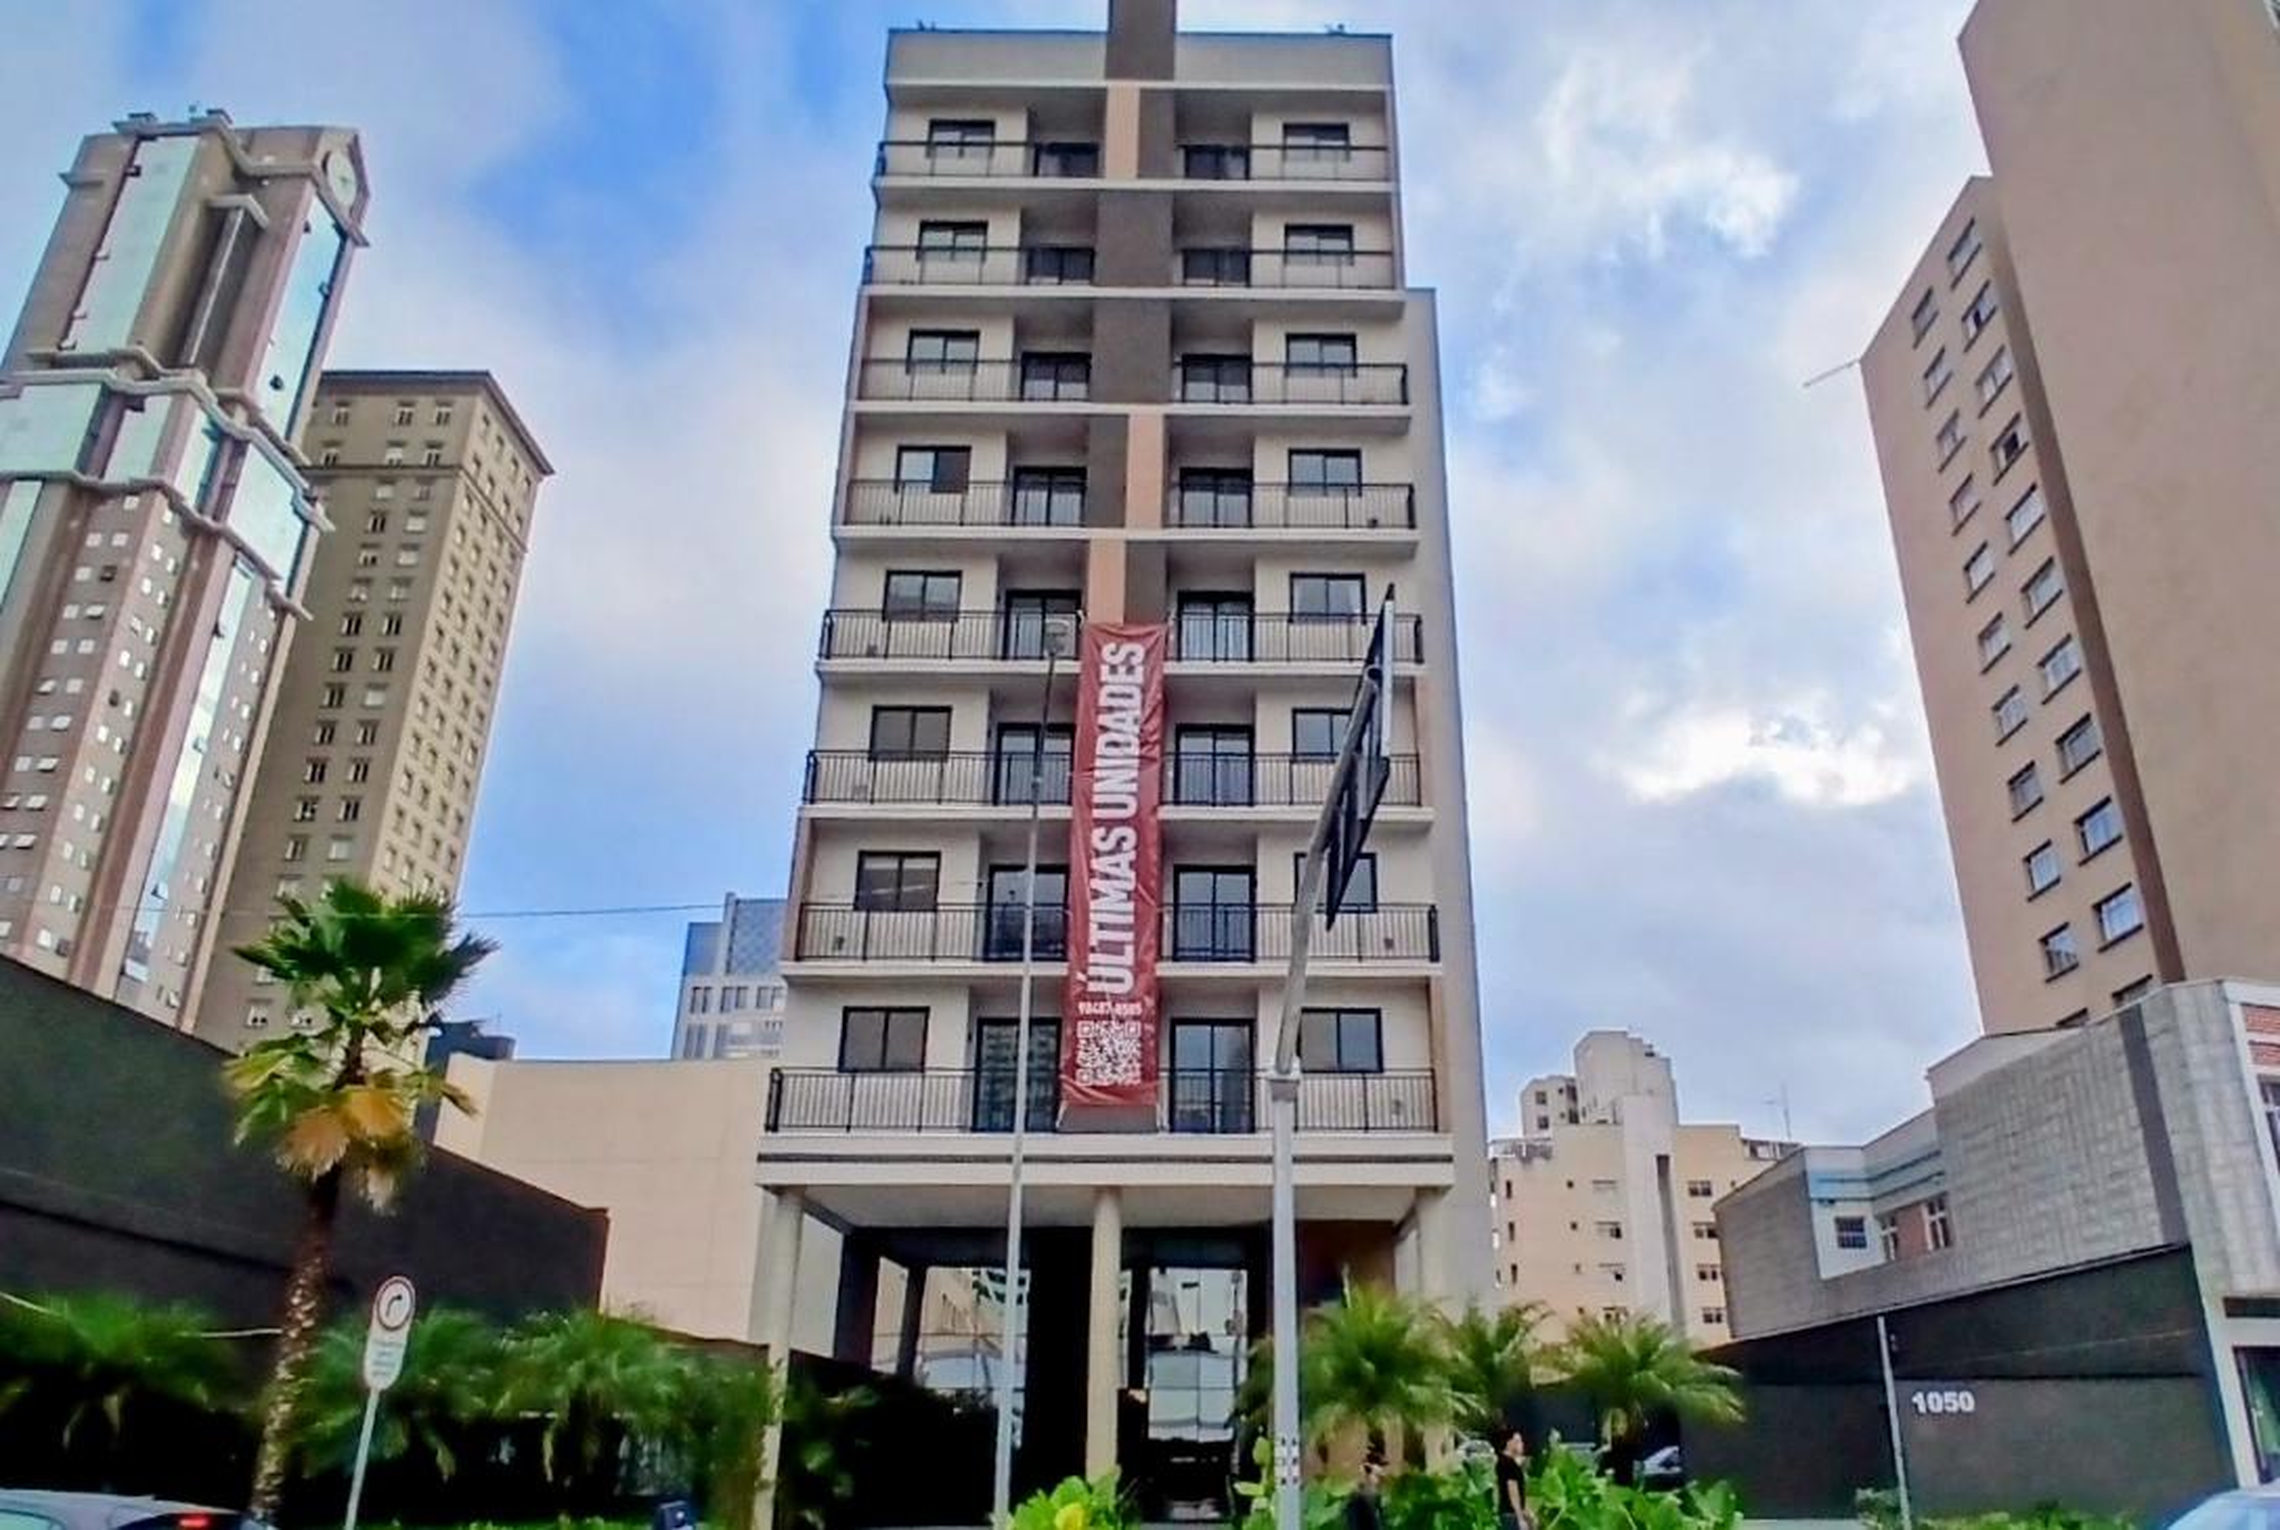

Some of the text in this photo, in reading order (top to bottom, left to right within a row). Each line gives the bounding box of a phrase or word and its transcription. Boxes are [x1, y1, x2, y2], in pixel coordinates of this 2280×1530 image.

[1092, 642, 1145, 819] UNIDADES
[1076, 826, 1137, 994] ÚLTIMAS
[1911, 1391, 1975, 1413] 1050
